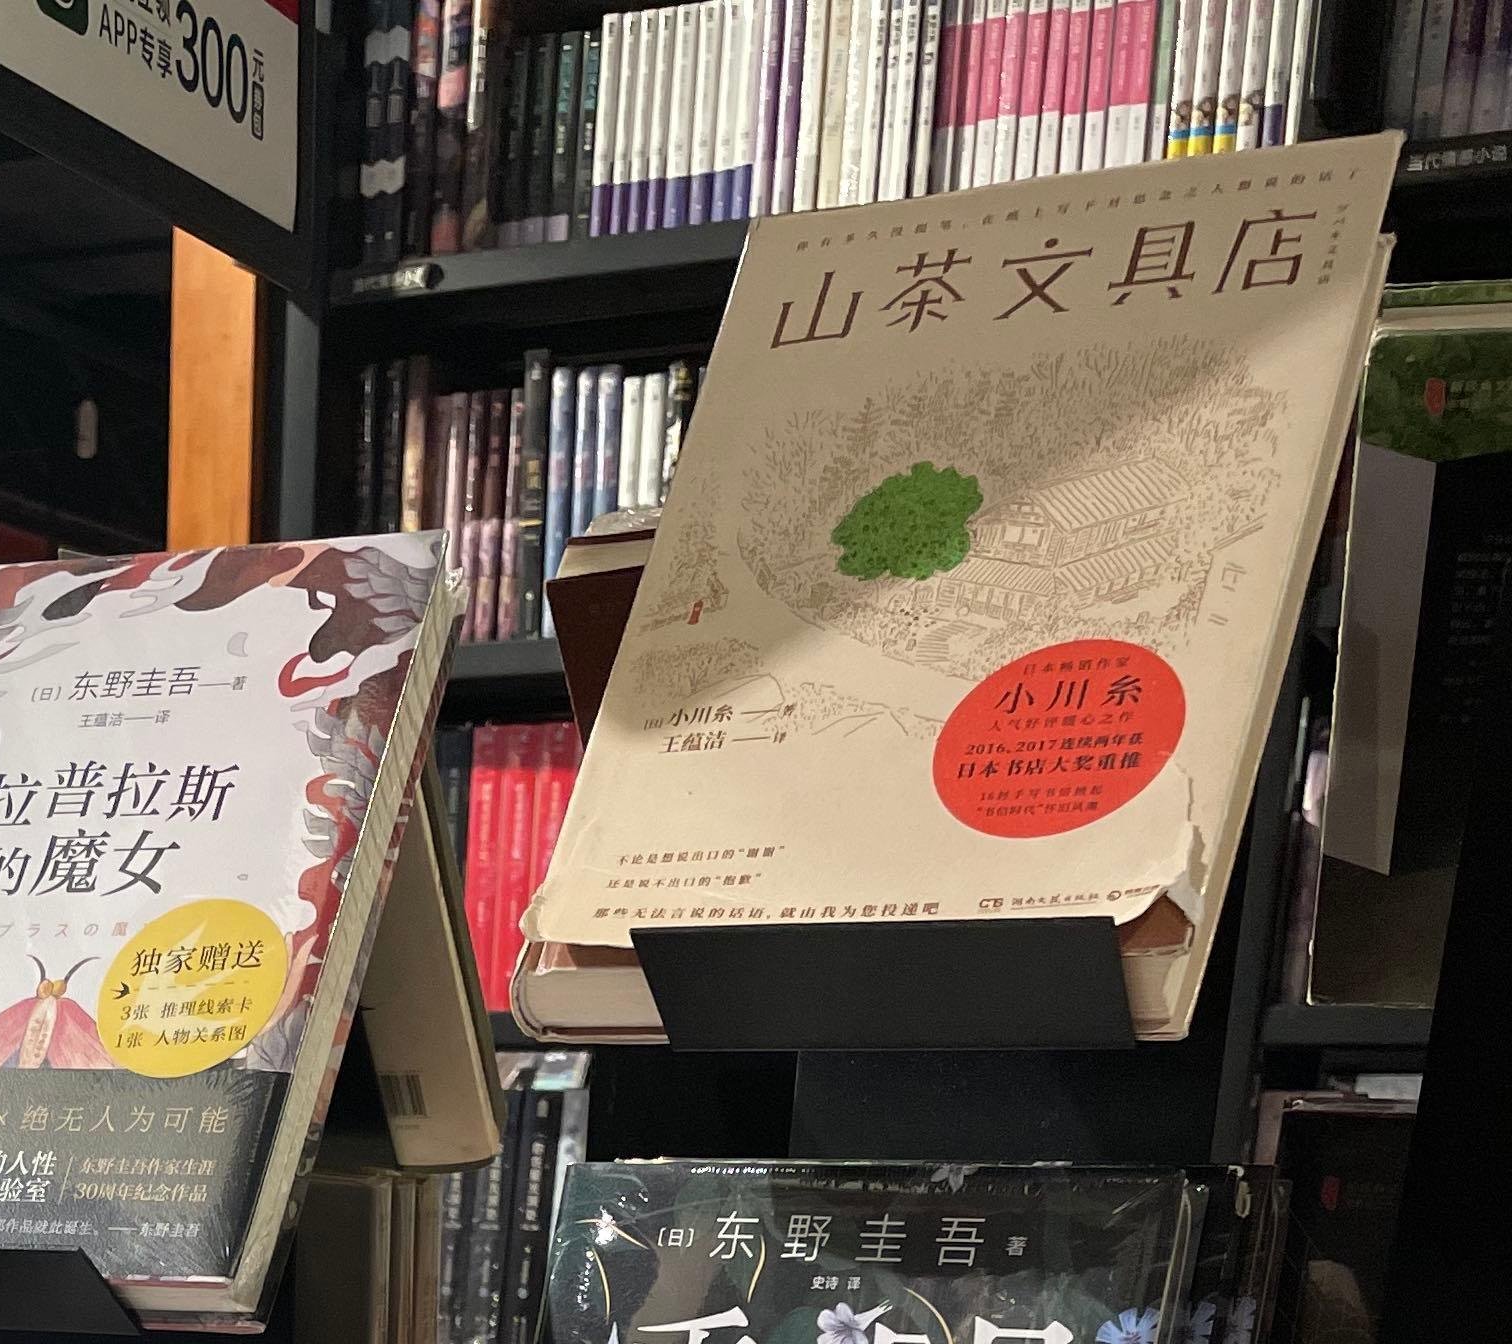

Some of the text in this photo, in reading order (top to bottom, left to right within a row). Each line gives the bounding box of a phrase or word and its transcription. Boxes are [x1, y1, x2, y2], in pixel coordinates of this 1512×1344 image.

[99, 4, 173, 79] APP专享
[176, 0, 247, 124] 300
[770, 208, 1319, 350] 山茶文具店
[993, 674, 1143, 715] 小川糸
[131, 940, 265, 977] 独家赠送
[120, 996, 254, 1021] 3张 推理线索卡
[114, 1024, 247, 1049] 1张 人物关系图
[709, 1209, 1029, 1268] 东野圭吾 著
